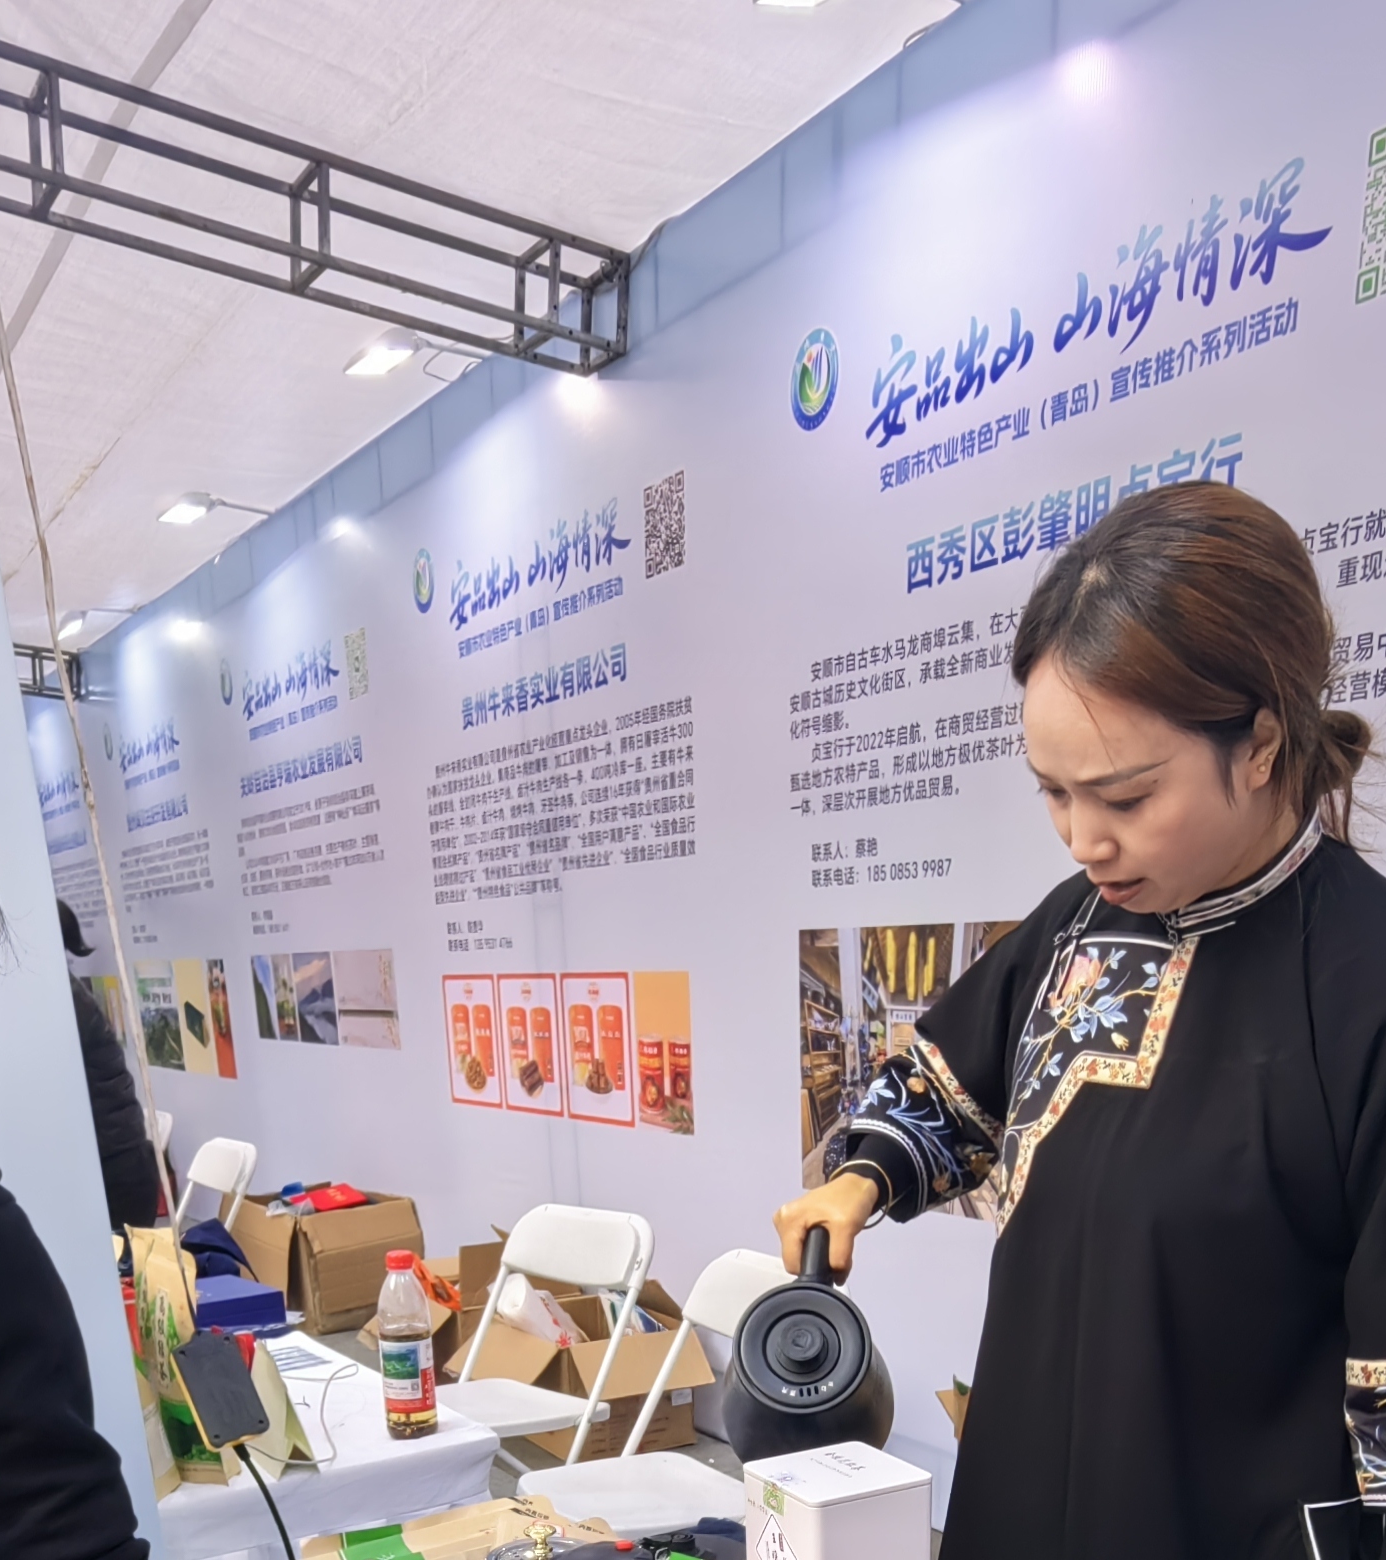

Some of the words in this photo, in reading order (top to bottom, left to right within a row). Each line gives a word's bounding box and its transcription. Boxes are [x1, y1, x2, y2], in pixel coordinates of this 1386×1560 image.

[865, 307, 1034, 448] 安品出山
[1053, 157, 1333, 355] 山海情深
